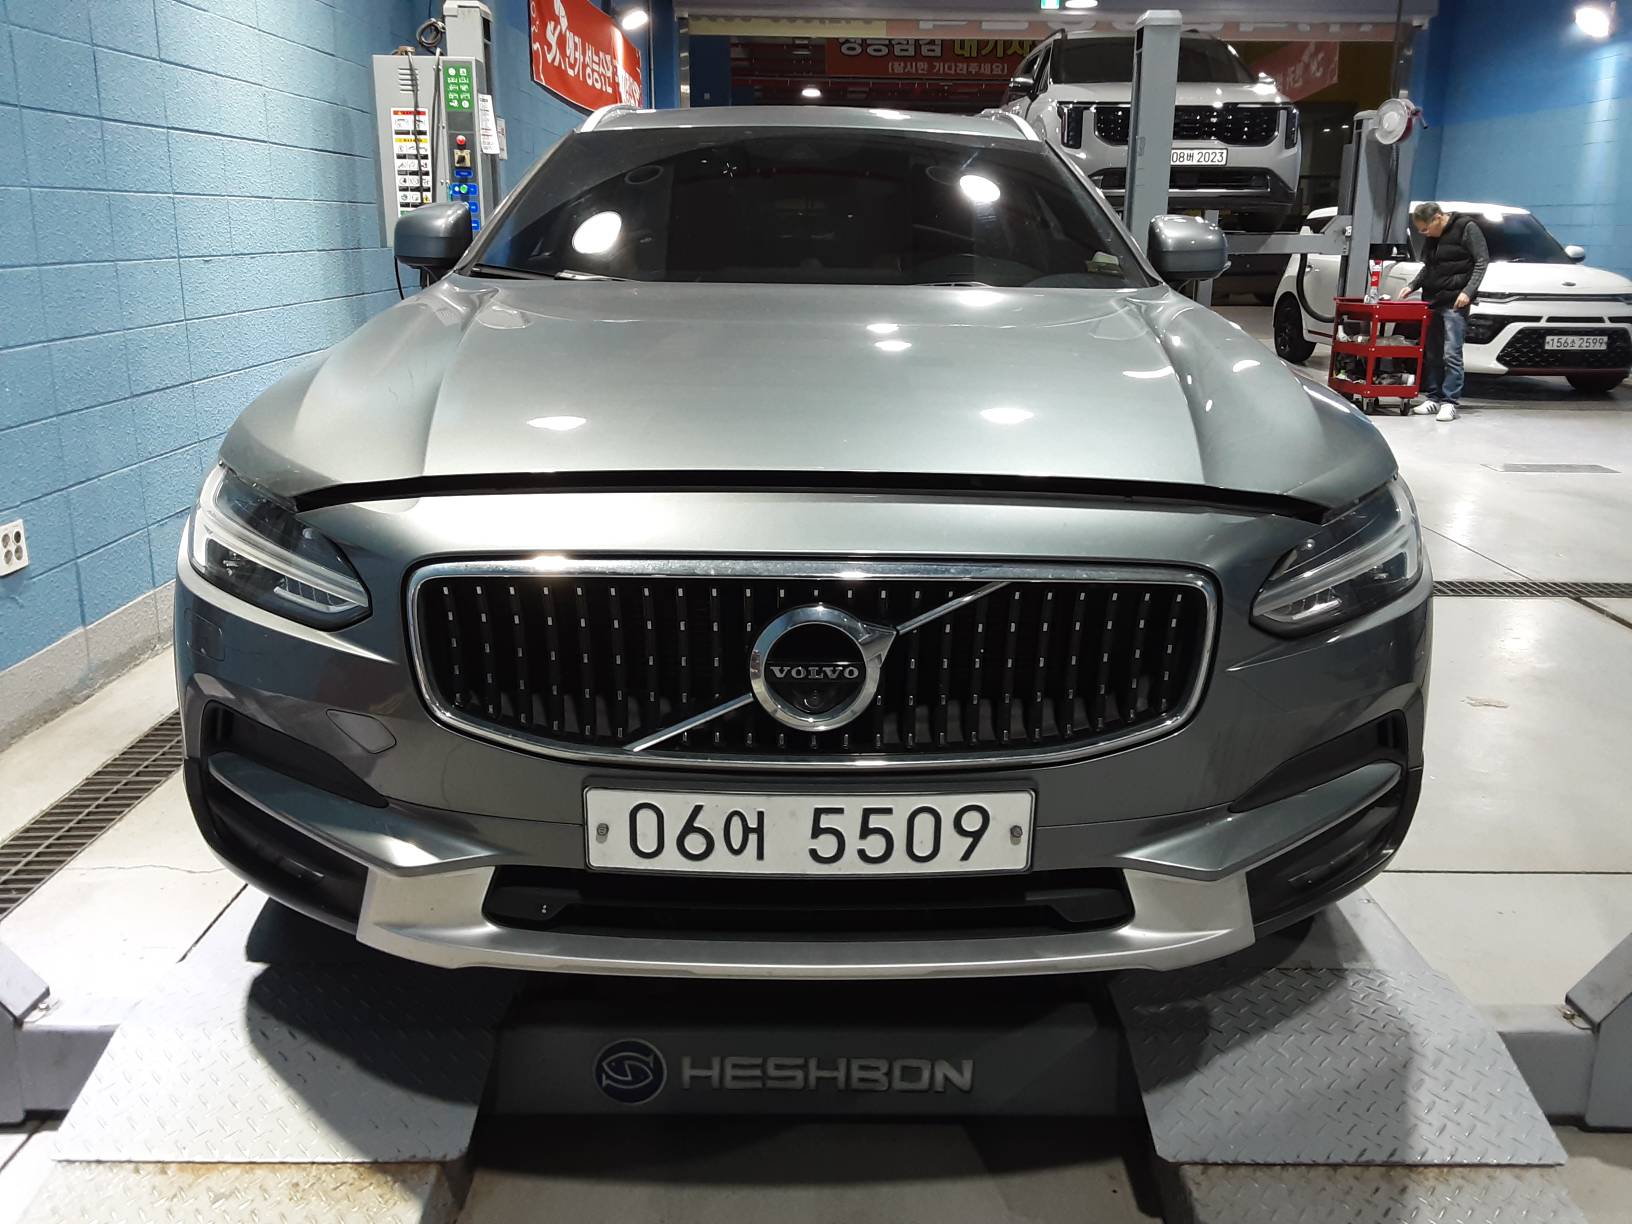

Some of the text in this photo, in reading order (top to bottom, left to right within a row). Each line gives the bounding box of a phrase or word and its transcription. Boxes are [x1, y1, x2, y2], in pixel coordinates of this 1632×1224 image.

[1197, 151, 1224, 163] 2023
[770, 666, 859, 679] VOLVO
[628, 801, 991, 865] 06어 5509
[681, 1055, 974, 1092] HESHBON
